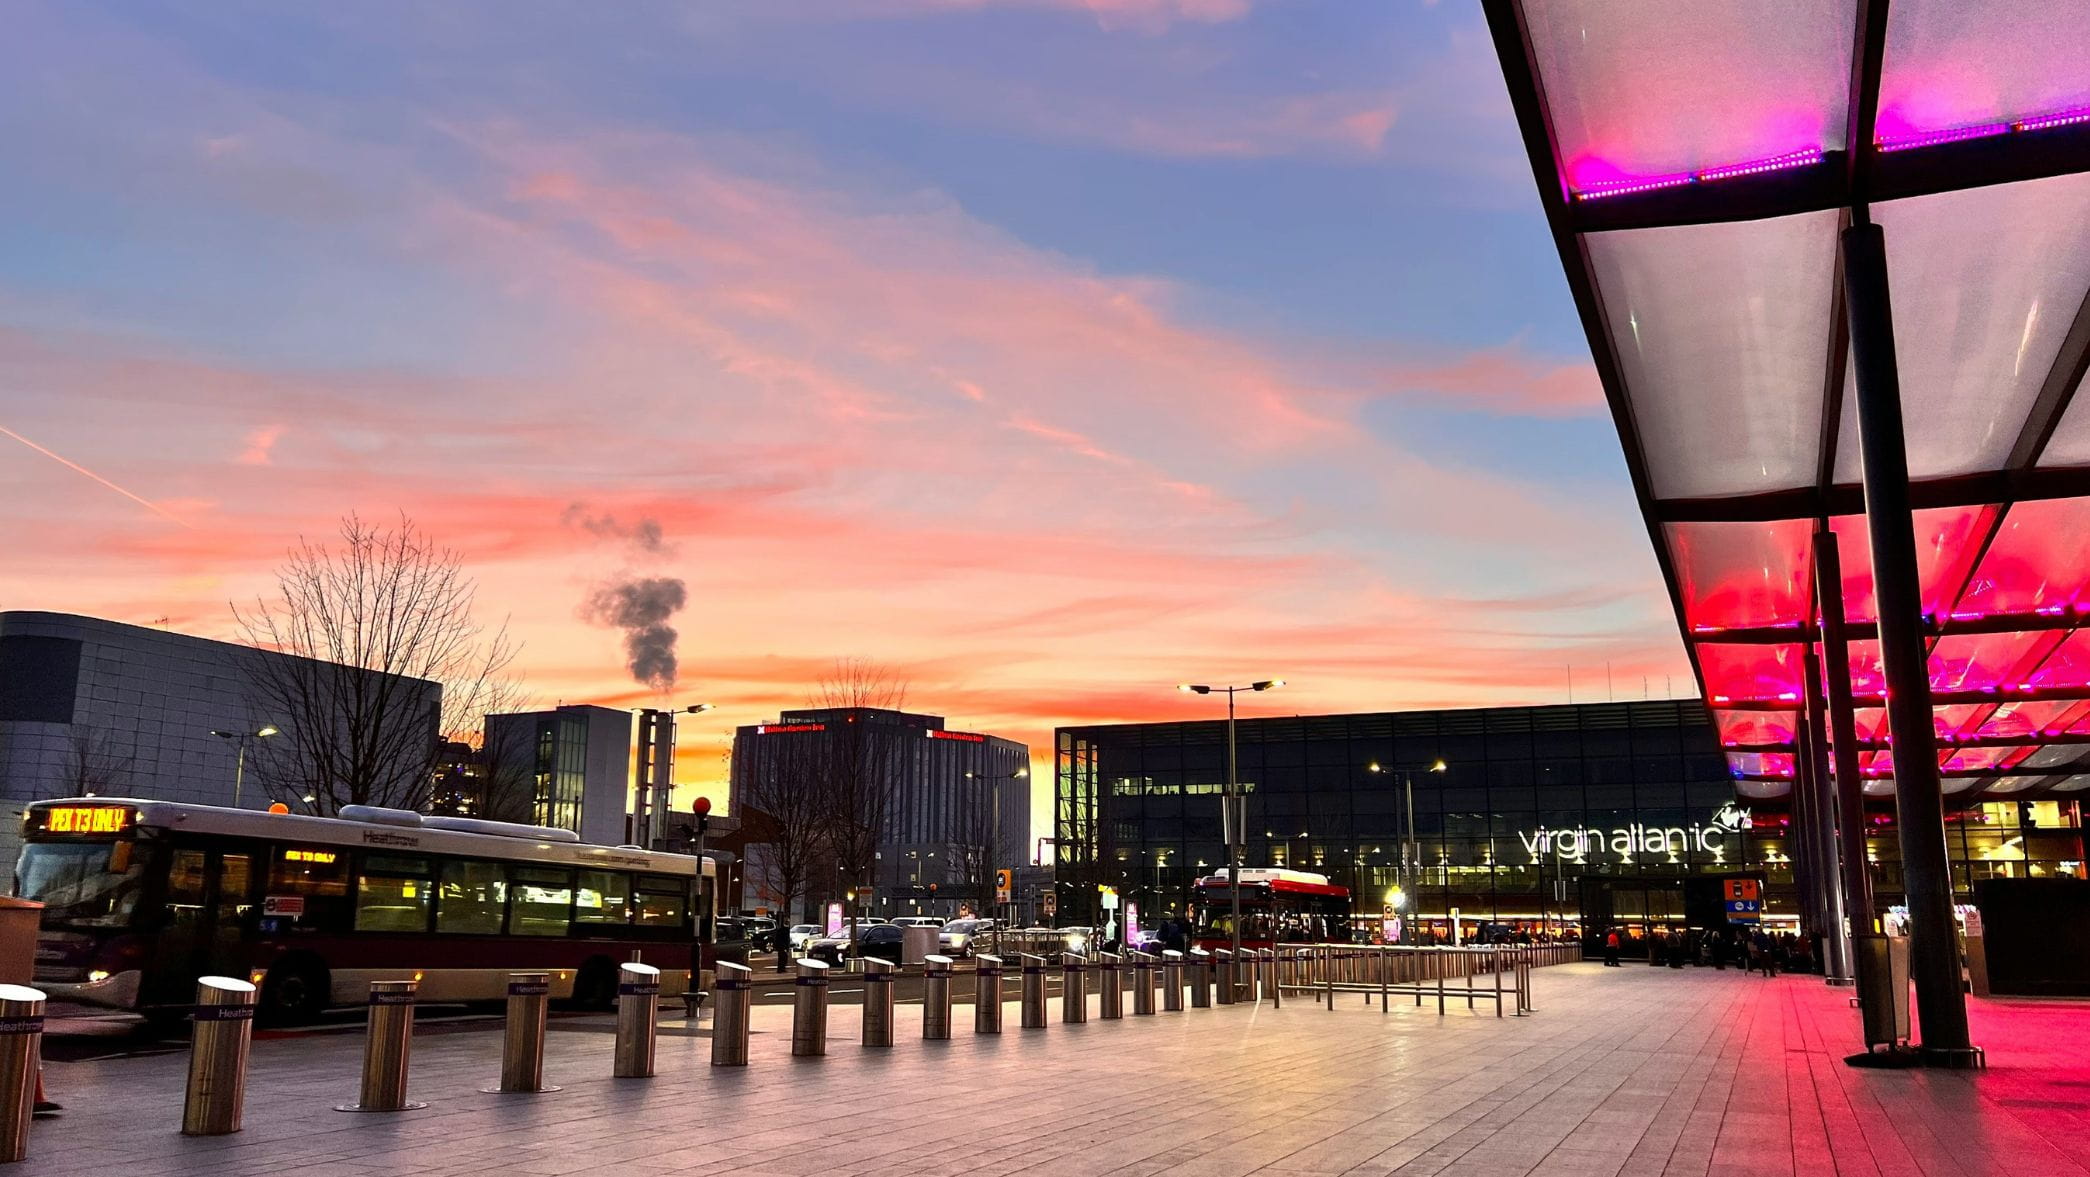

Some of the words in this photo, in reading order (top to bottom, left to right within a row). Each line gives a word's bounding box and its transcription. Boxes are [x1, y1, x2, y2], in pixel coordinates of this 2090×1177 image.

[75, 808, 93, 832] T3
[92, 808, 125, 832] ONLY
[1518, 824, 1605, 859] virgin
